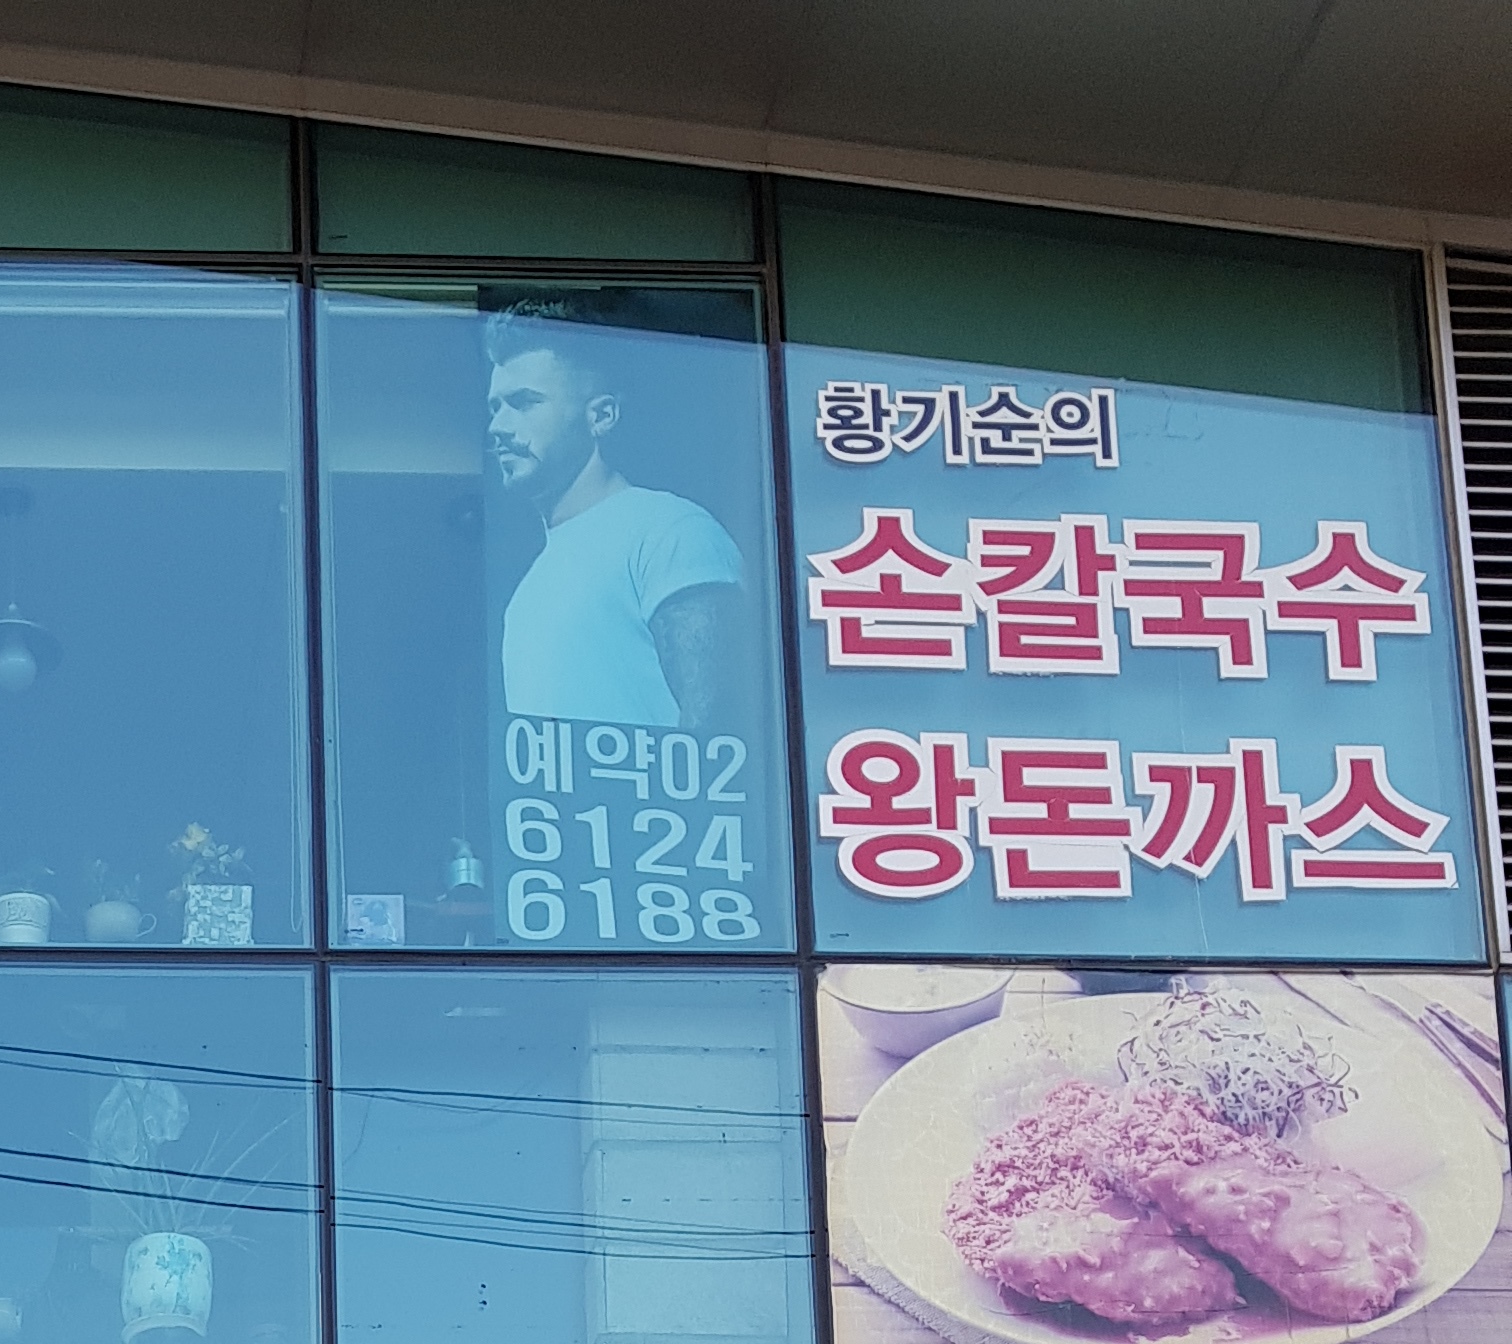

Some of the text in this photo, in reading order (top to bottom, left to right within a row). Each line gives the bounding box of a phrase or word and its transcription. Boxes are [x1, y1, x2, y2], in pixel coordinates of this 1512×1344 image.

[816, 381, 1119, 468] 황기순의
[809, 506, 1431, 682] 손칼국수
[507, 798, 753, 881] 6124
[820, 730, 1458, 902] 왕돈까스
[508, 870, 760, 944] 6188
